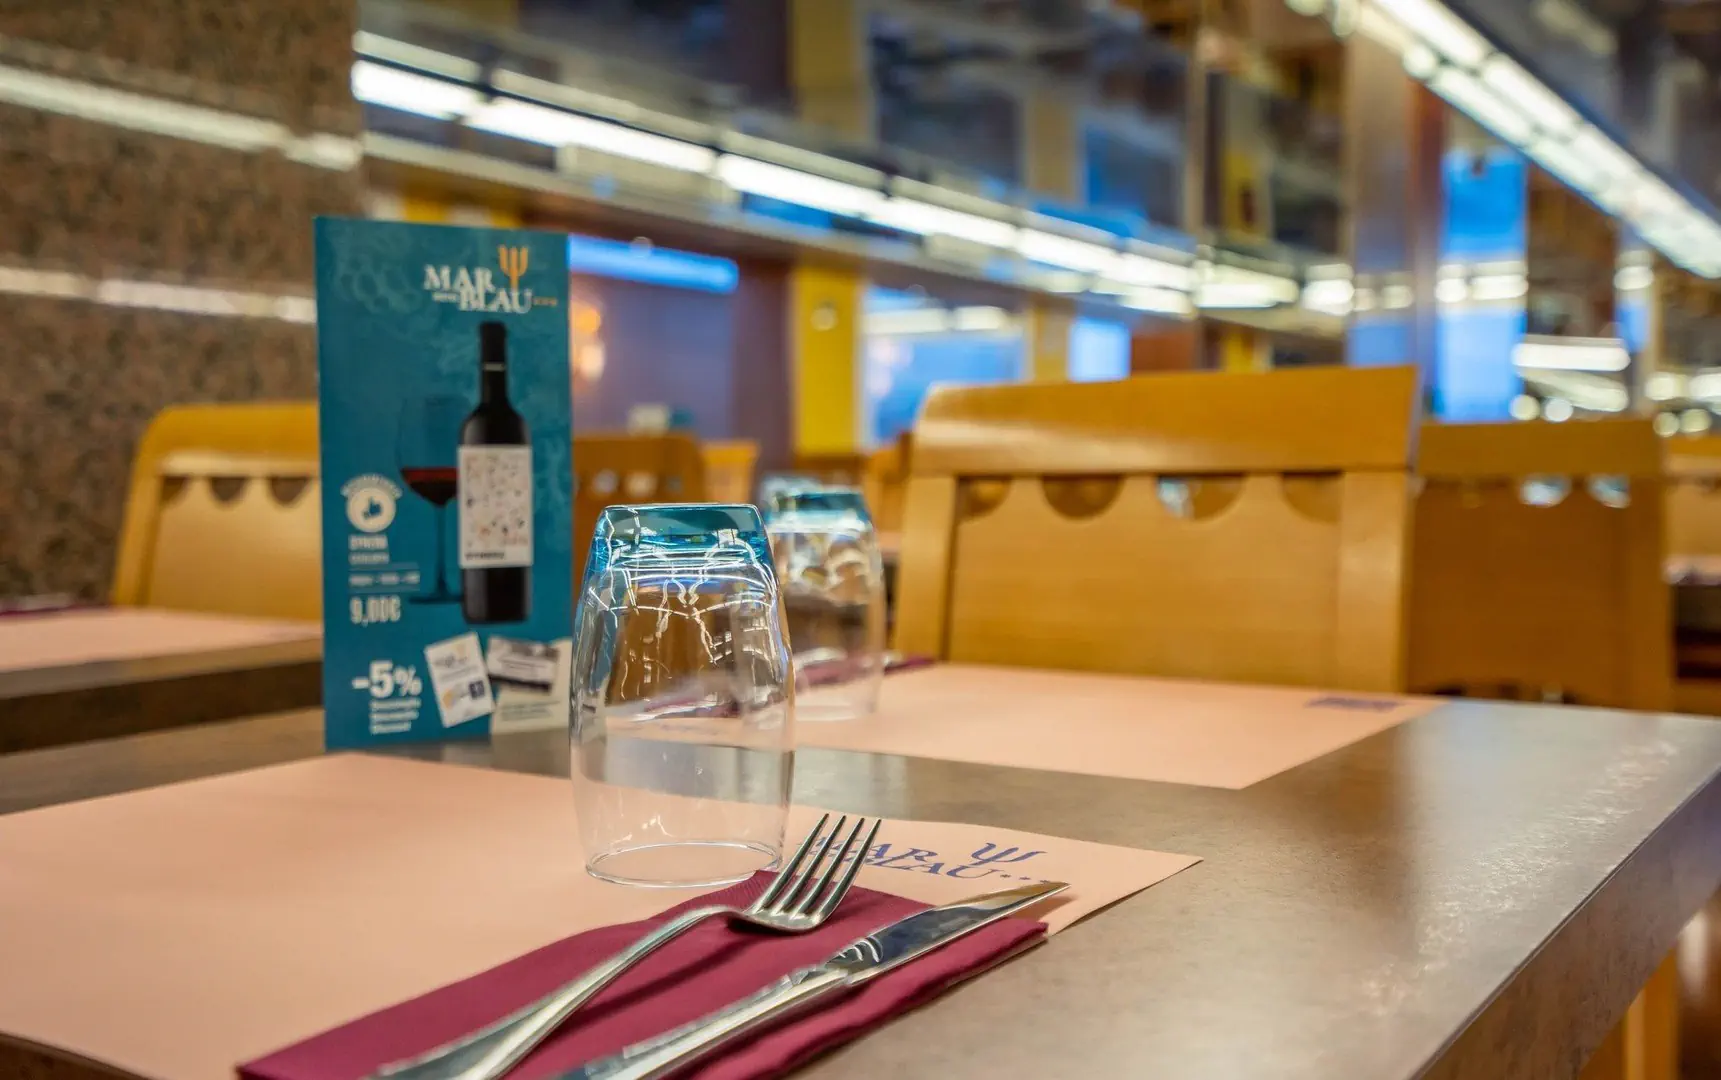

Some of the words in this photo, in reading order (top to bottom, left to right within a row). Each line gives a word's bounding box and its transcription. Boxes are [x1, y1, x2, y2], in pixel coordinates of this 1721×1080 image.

[423, 263, 496, 293] MAR
[458, 287, 533, 314] BLAU
[351, 660, 423, 699] -5%
[842, 853, 1003, 879] LAU
